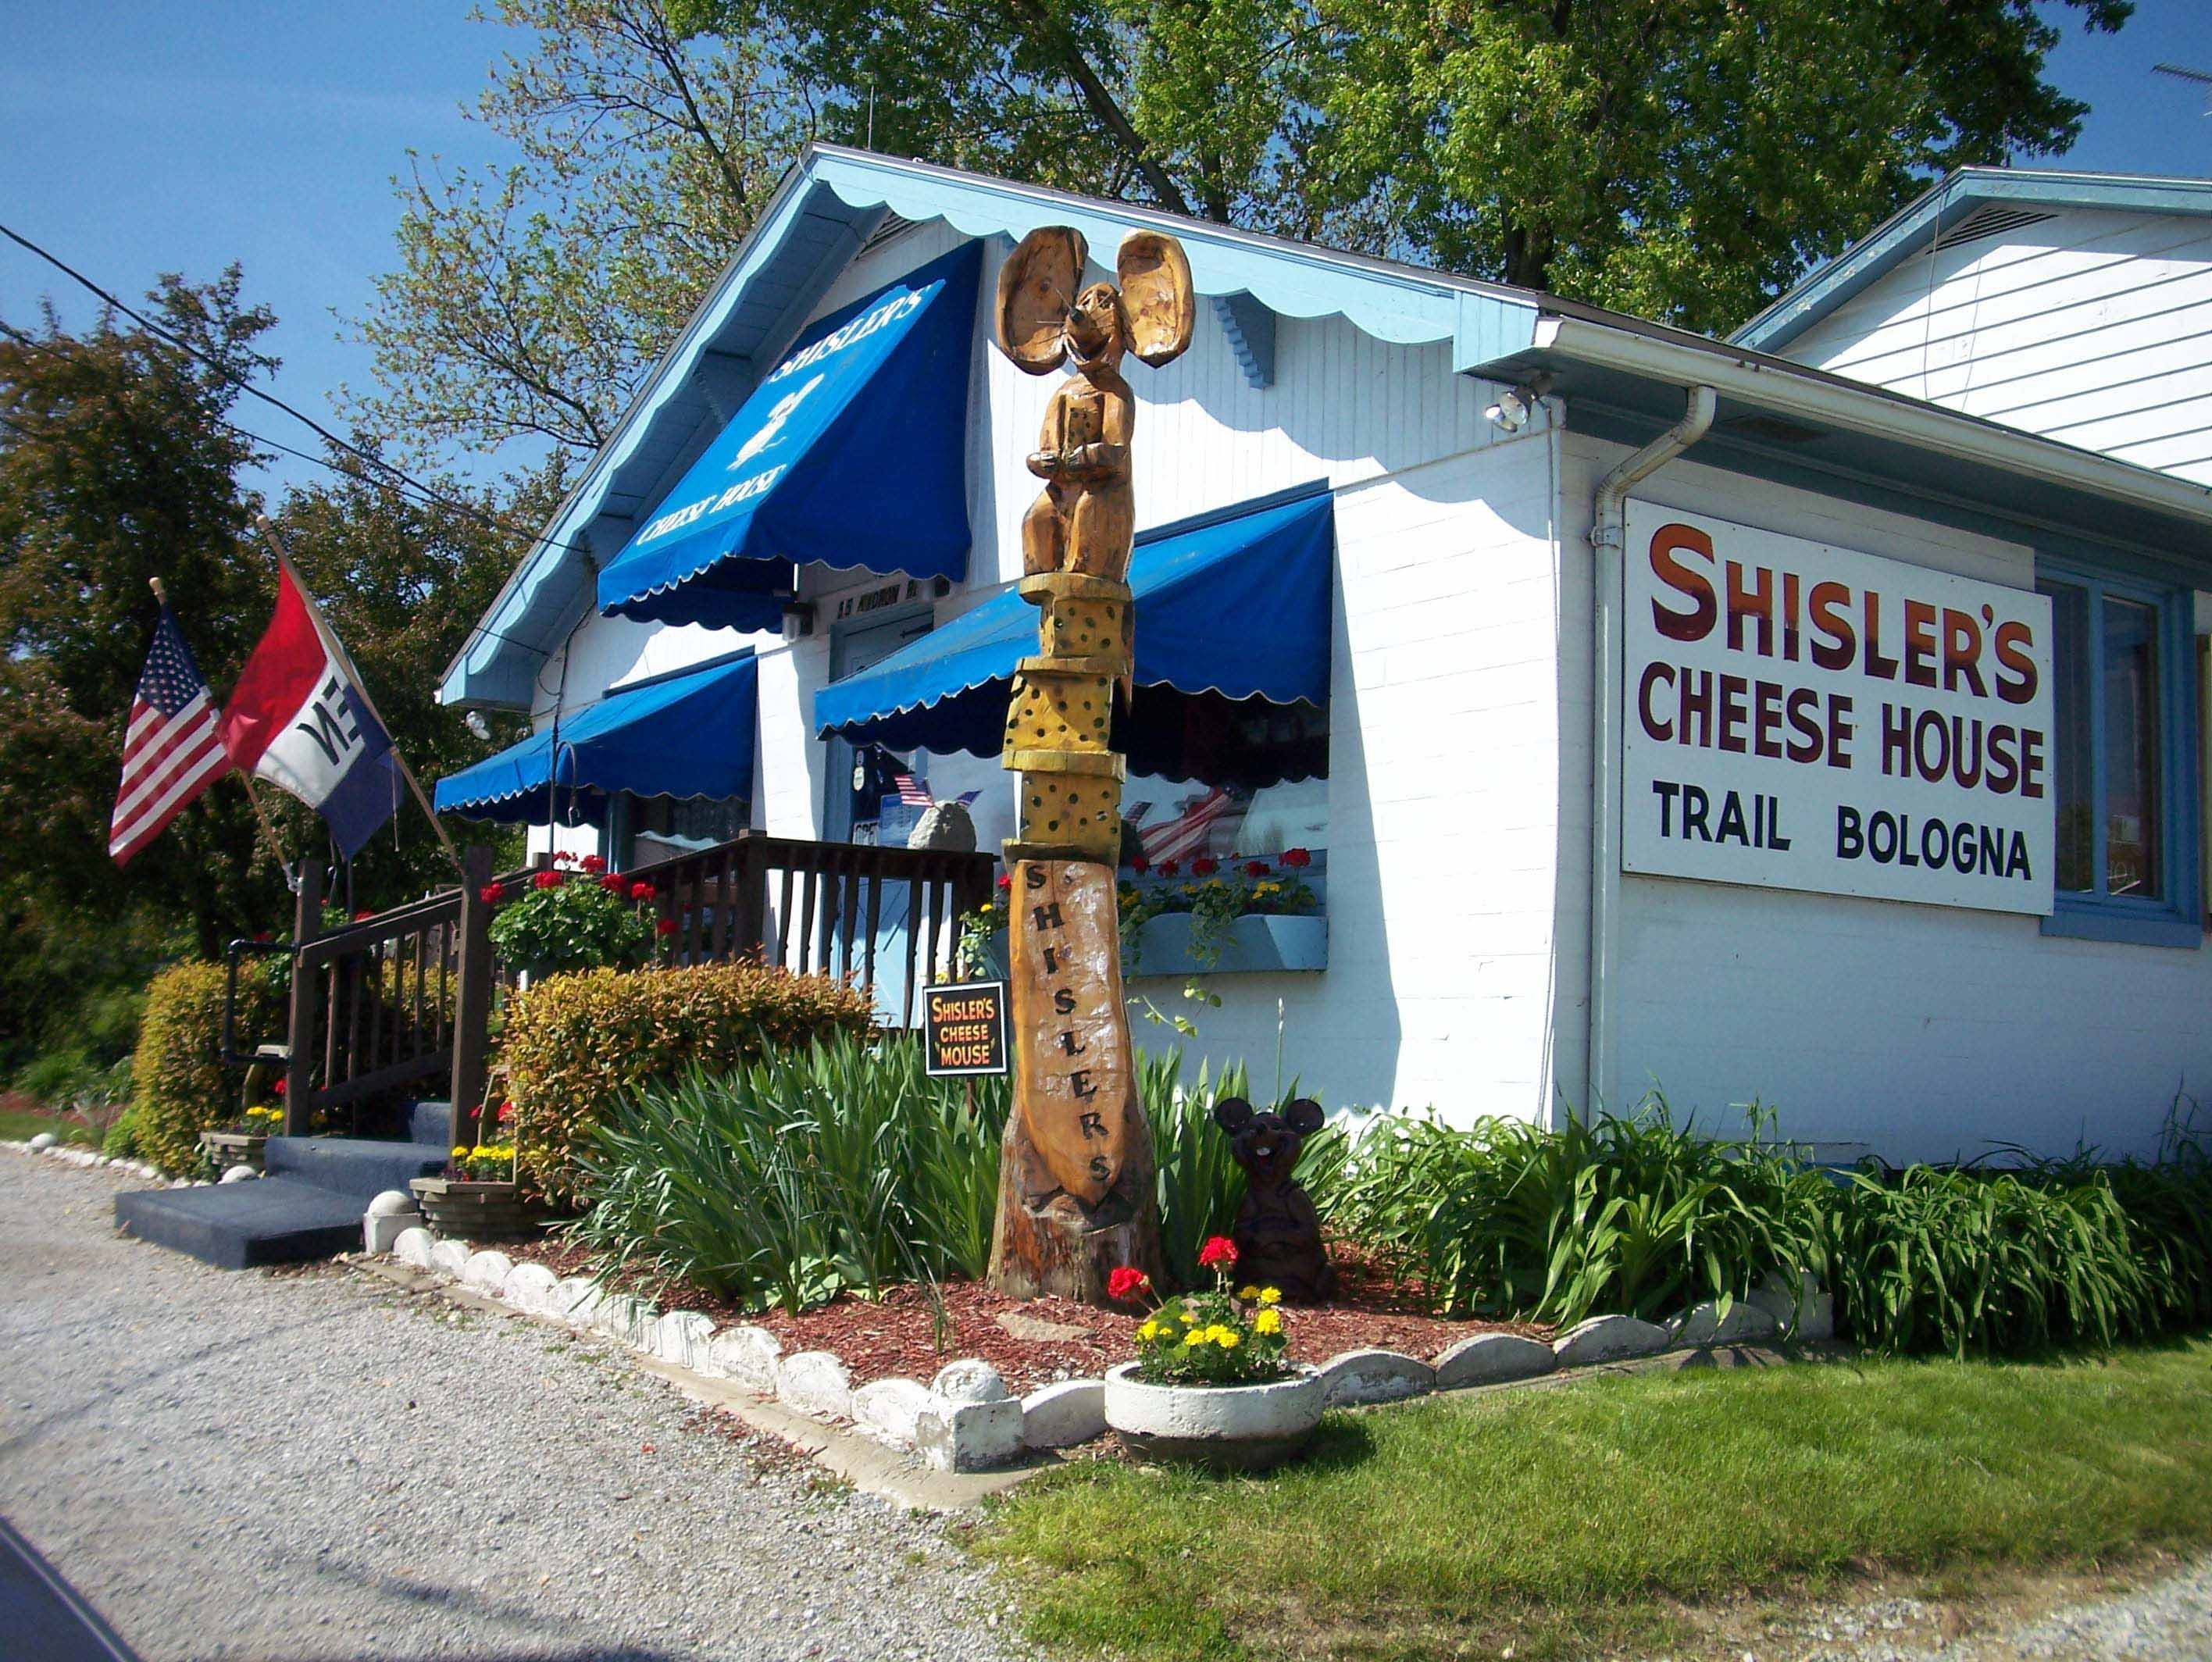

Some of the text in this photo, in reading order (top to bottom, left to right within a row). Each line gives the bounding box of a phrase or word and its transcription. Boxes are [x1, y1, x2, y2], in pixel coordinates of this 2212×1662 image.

[636, 463, 788, 546] CHEESE HOUSE
[1649, 522, 2039, 704] SHISLER'S
[1638, 662, 2044, 798] CHEESE HOUSE
[1652, 779, 2032, 881] TRAIL BOLOGNA
[931, 996, 995, 1023] SHISLER'S
[940, 1024, 989, 1043] CHEESE
[940, 1043, 991, 1067] MOUSE
